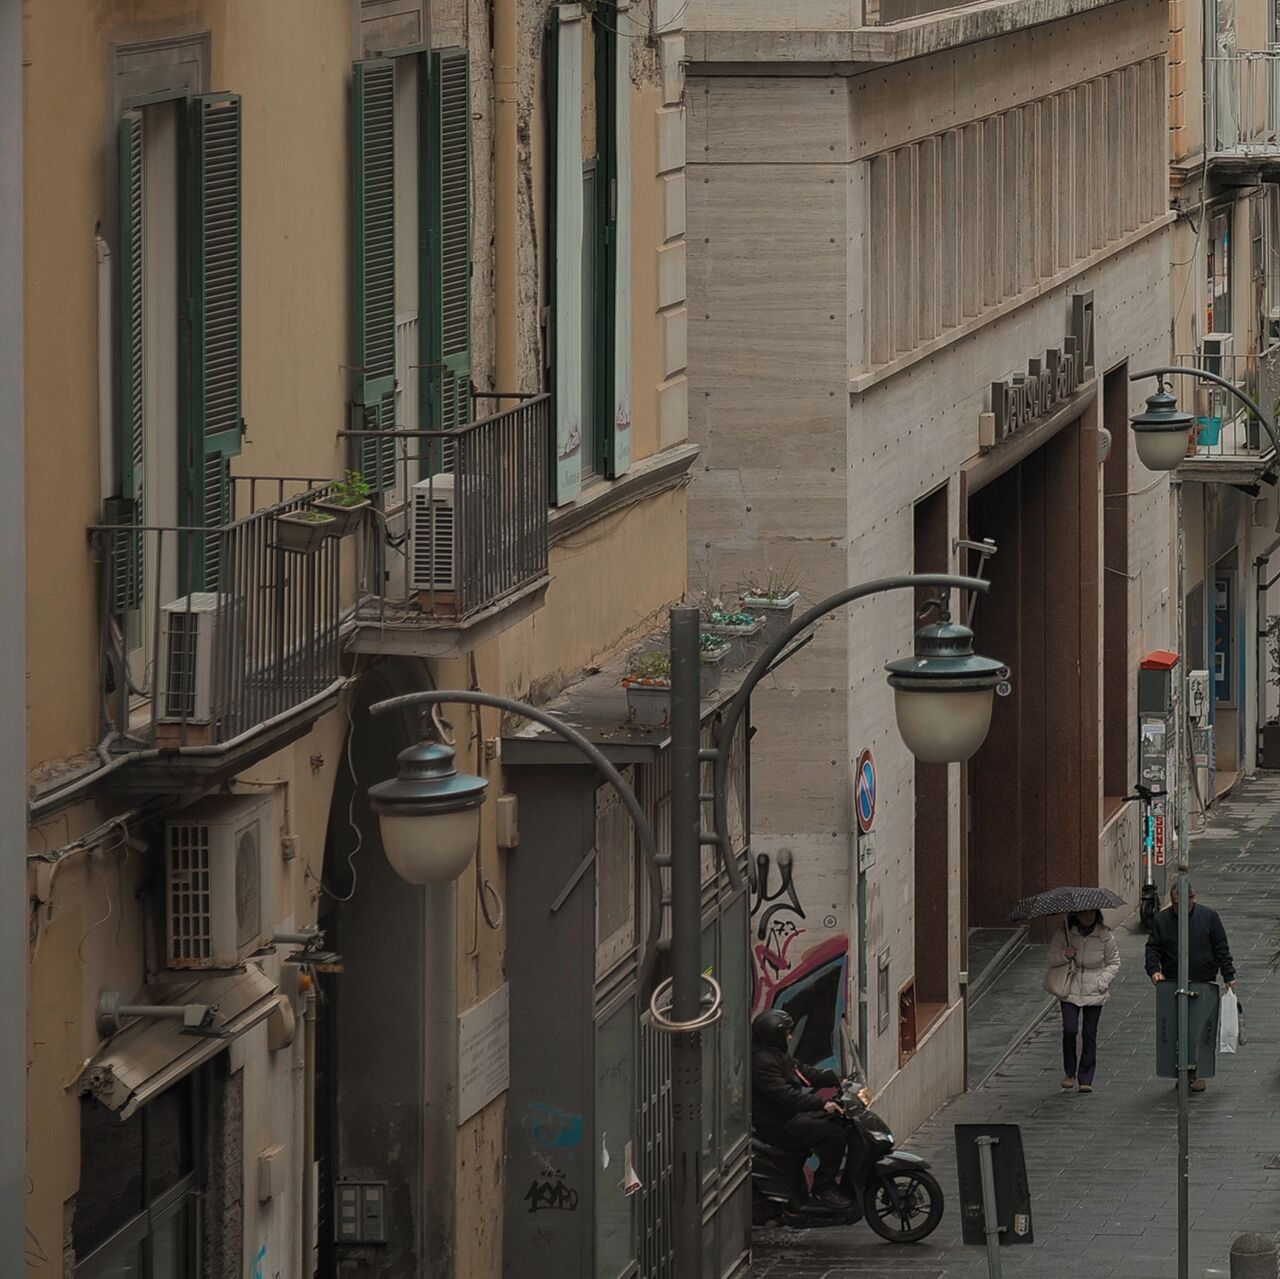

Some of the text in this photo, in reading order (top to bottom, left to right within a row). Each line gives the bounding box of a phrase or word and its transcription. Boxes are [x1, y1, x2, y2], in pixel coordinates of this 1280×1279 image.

[991, 336, 1080, 440] Deutsche Bank
[1155, 816, 1164, 865] SONIC
